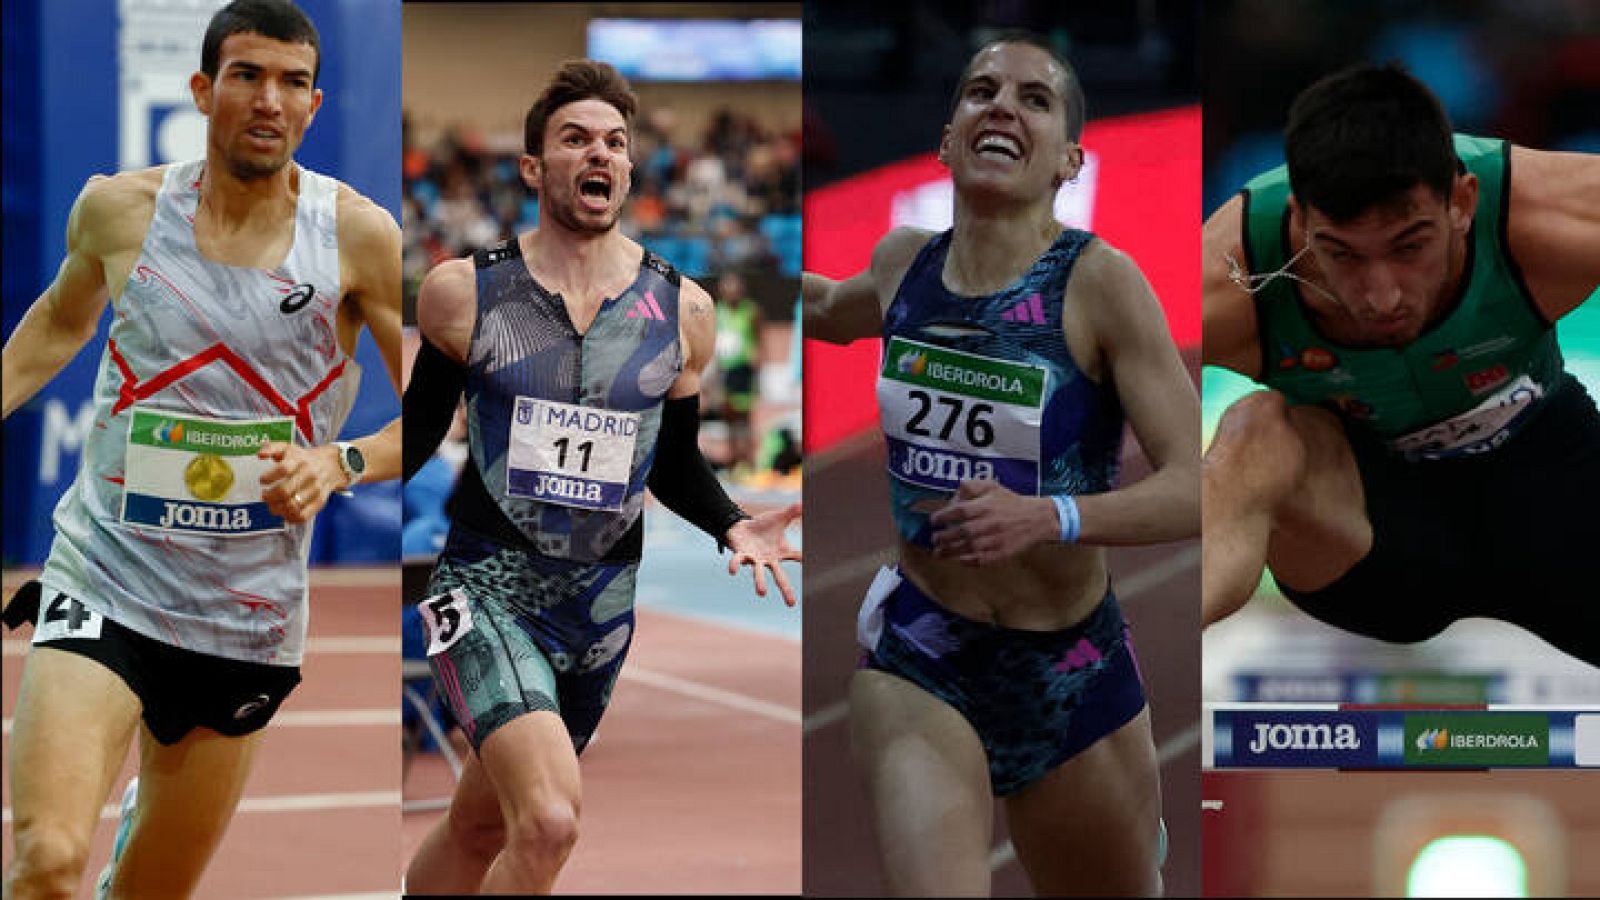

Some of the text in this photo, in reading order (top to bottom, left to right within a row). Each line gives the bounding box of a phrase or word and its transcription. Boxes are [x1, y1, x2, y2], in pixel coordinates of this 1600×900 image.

[926, 362, 1023, 395] IBERDROLA
[547, 407, 639, 436] MADRID
[905, 390, 995, 448] 276
[553, 437, 594, 472] 11
[534, 474, 602, 502] Joma
[160, 501, 252, 530] Joma
[45, 592, 91, 630] 4
[429, 594, 461, 642] 5
[1250, 723, 1361, 754] Joma
[1450, 734, 1539, 748] IBERDROLA
